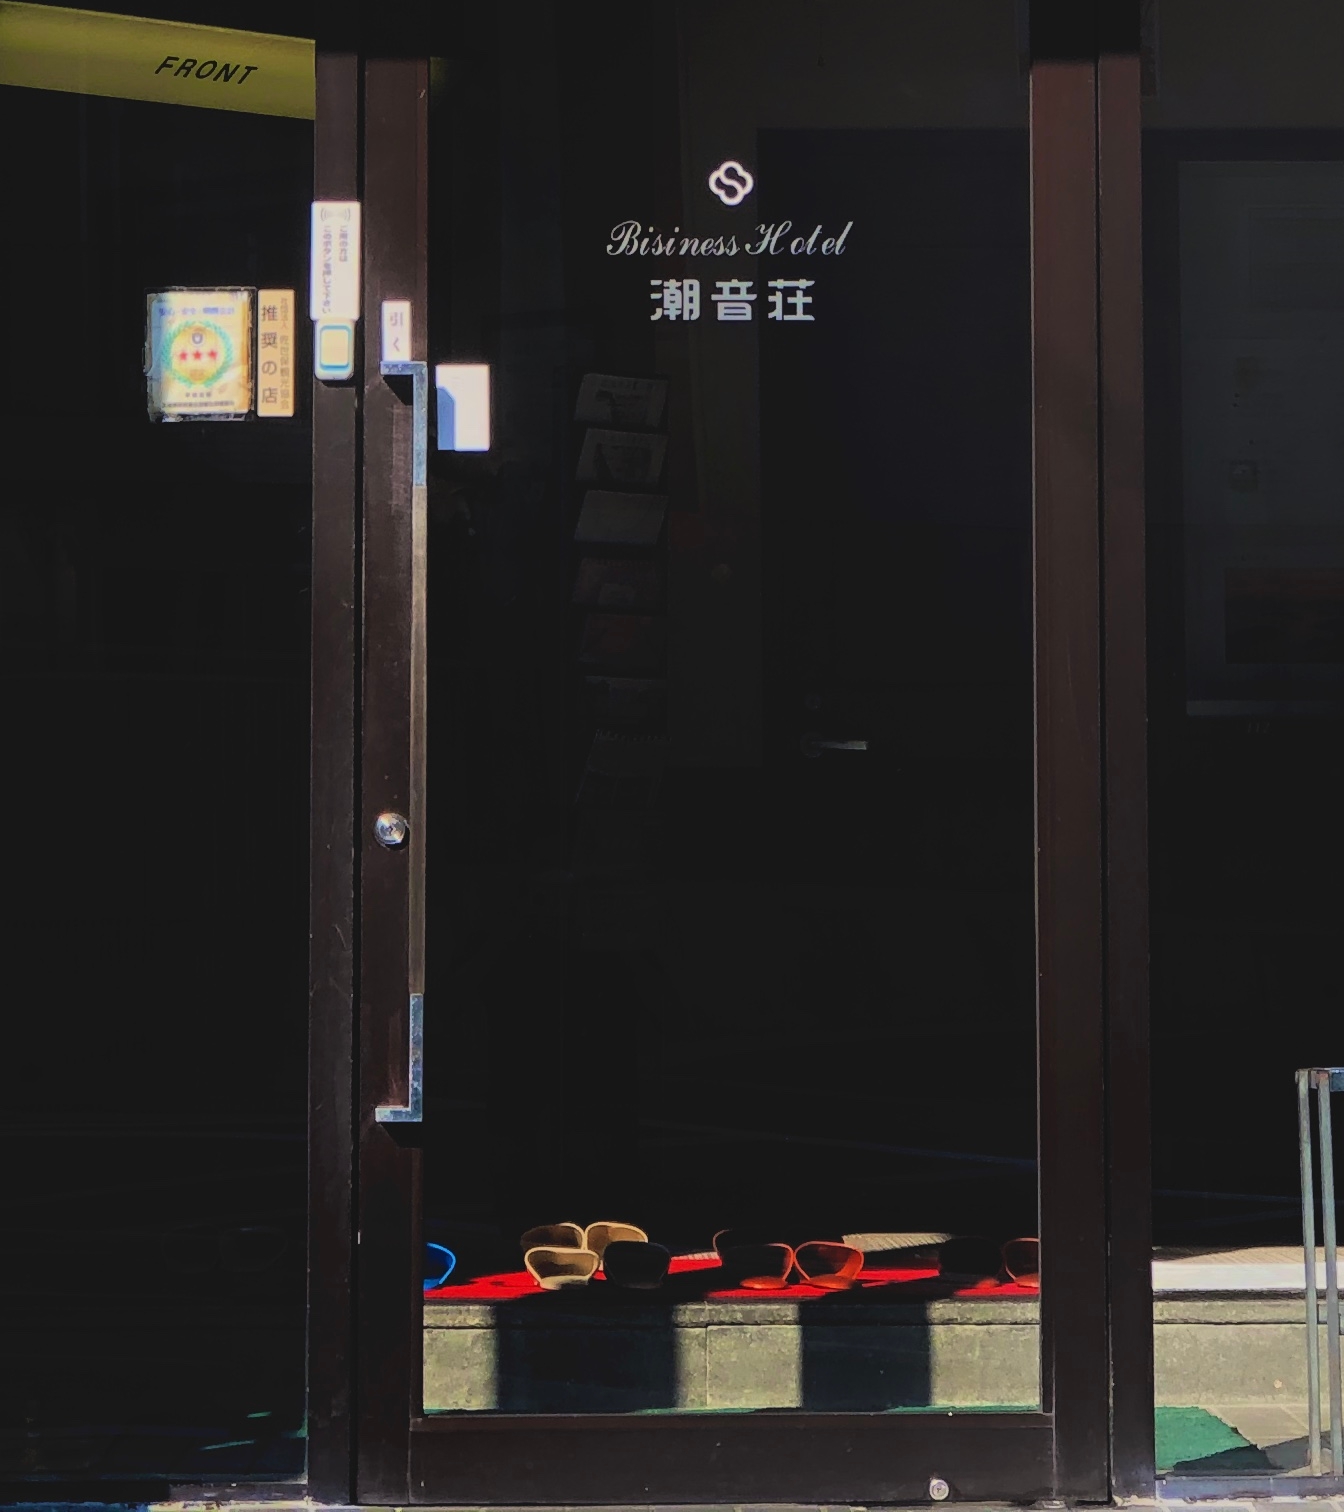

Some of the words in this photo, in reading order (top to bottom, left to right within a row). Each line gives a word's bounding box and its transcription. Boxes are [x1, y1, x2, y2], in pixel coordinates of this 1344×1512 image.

[154, 55, 258, 86] FRONT
[606, 220, 741, 257] Bisiness
[745, 220, 854, 257] Hotel
[650, 278, 816, 321] 潮音荘
[390, 311, 404, 352] 引く
[261, 304, 278, 405] 推奨の店
